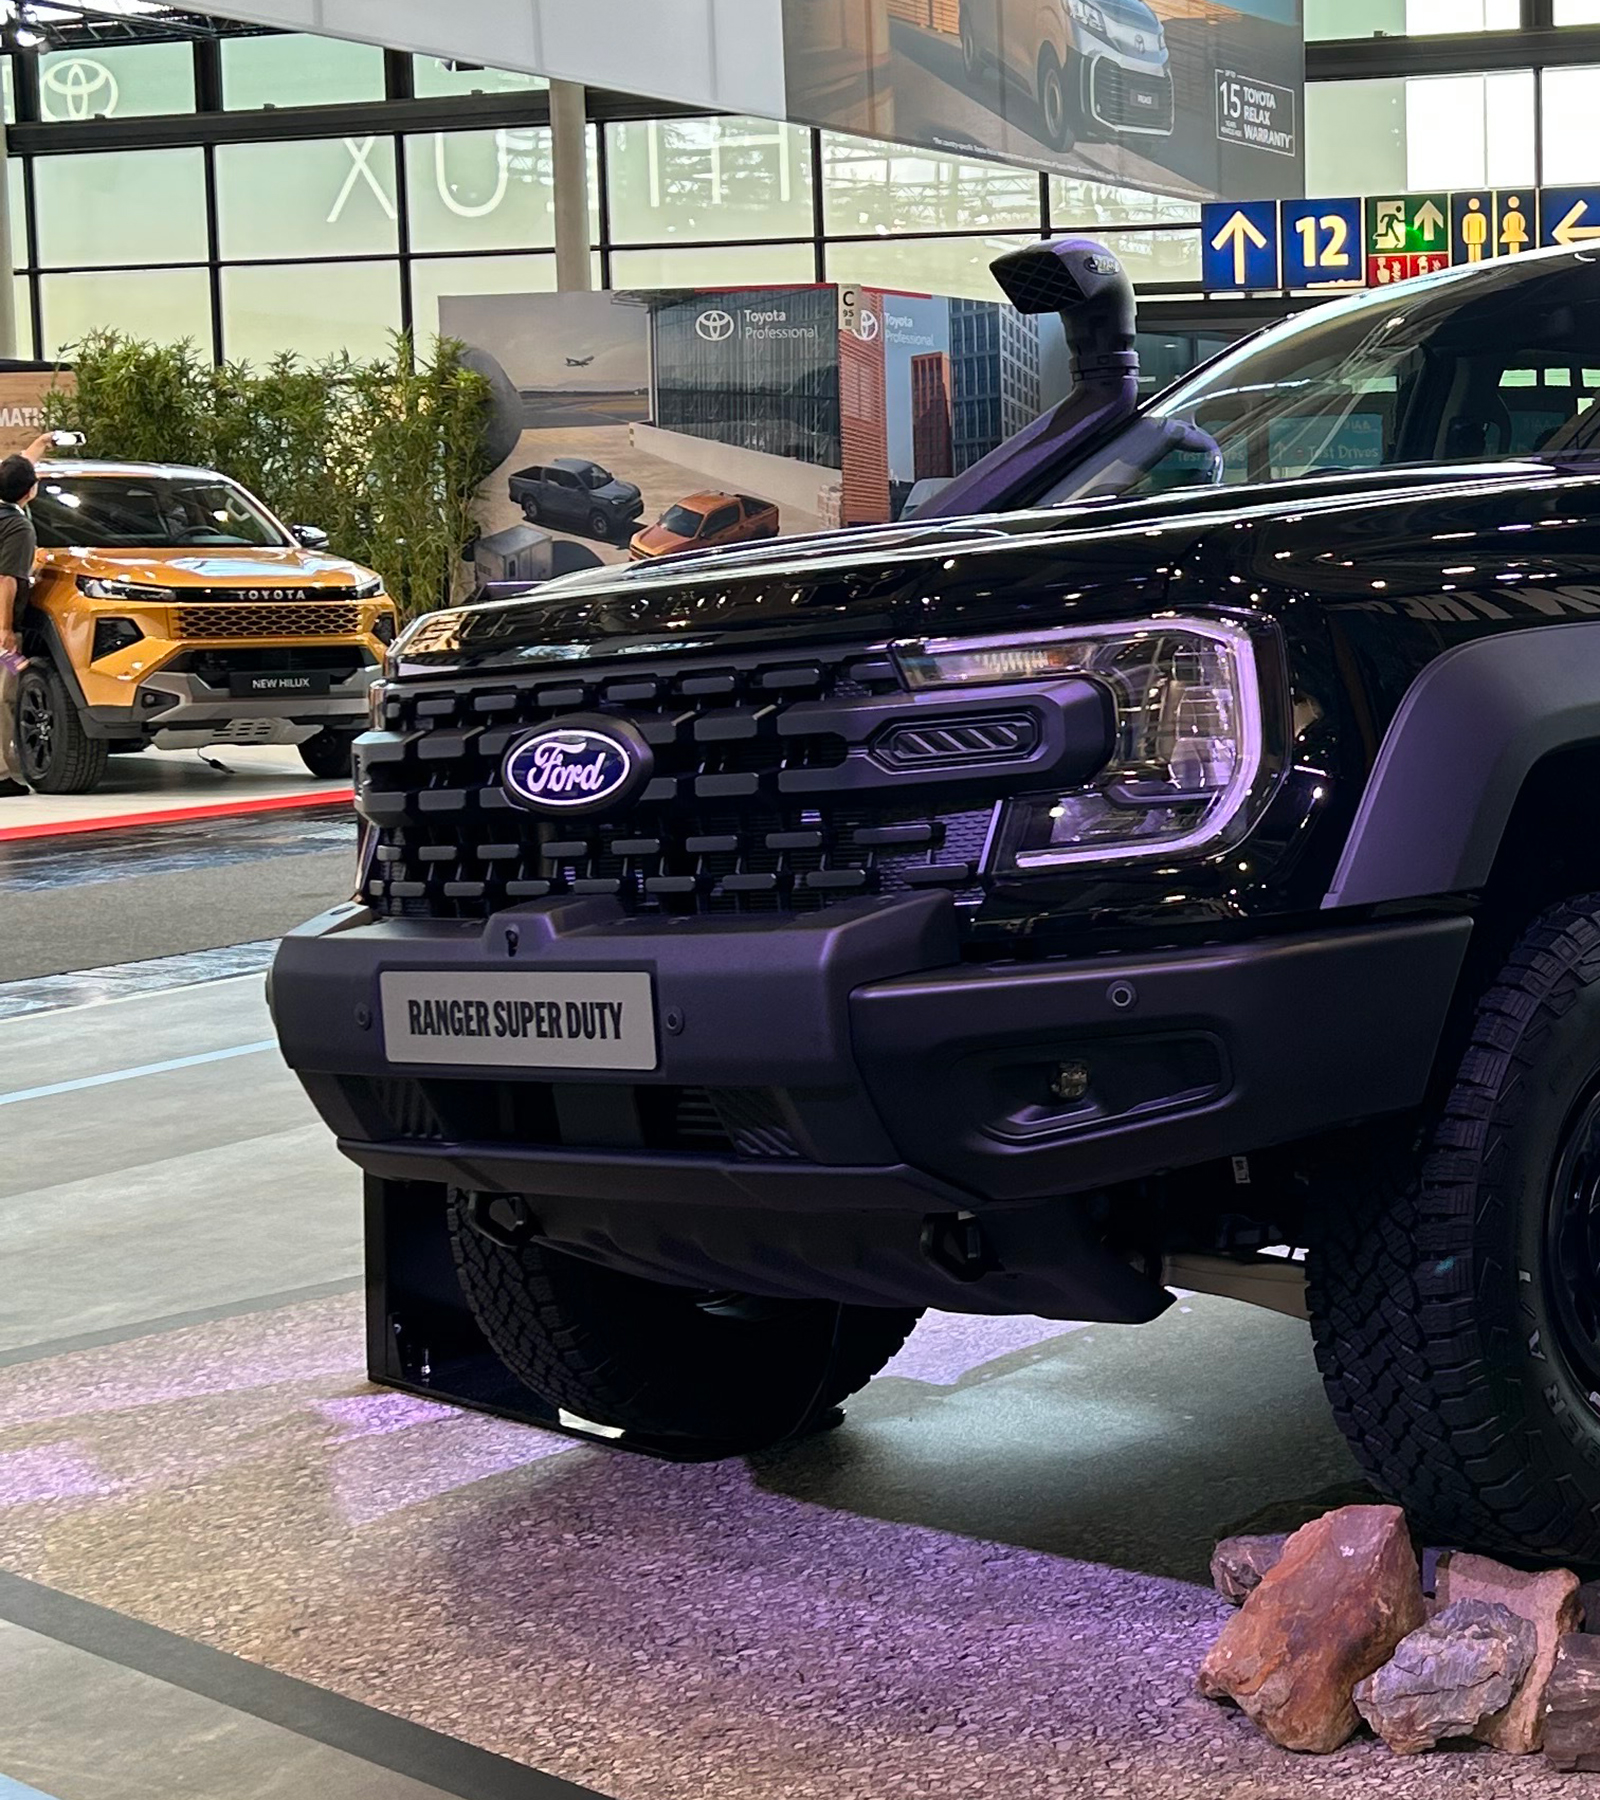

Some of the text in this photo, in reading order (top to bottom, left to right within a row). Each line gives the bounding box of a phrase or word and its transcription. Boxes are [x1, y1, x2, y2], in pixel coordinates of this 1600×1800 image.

[1220, 81, 1241, 118] 15
[1243, 86, 1276, 109] TOYOTA
[1243, 105, 1271, 126] RELAX
[1295, 214, 1349, 268] 12
[843, 291, 854, 306] C
[744, 309, 786, 323] Toyota
[884, 311, 914, 328] Toyota
[745, 324, 819, 340] Professional
[885, 330, 935, 347] Professional
[237, 590, 306, 600] TOYOTA
[252, 678, 310, 689] NEW HILUX
[527, 742, 605, 792] Ford
[408, 1000, 623, 1039] RANGER SUPER DUTY
